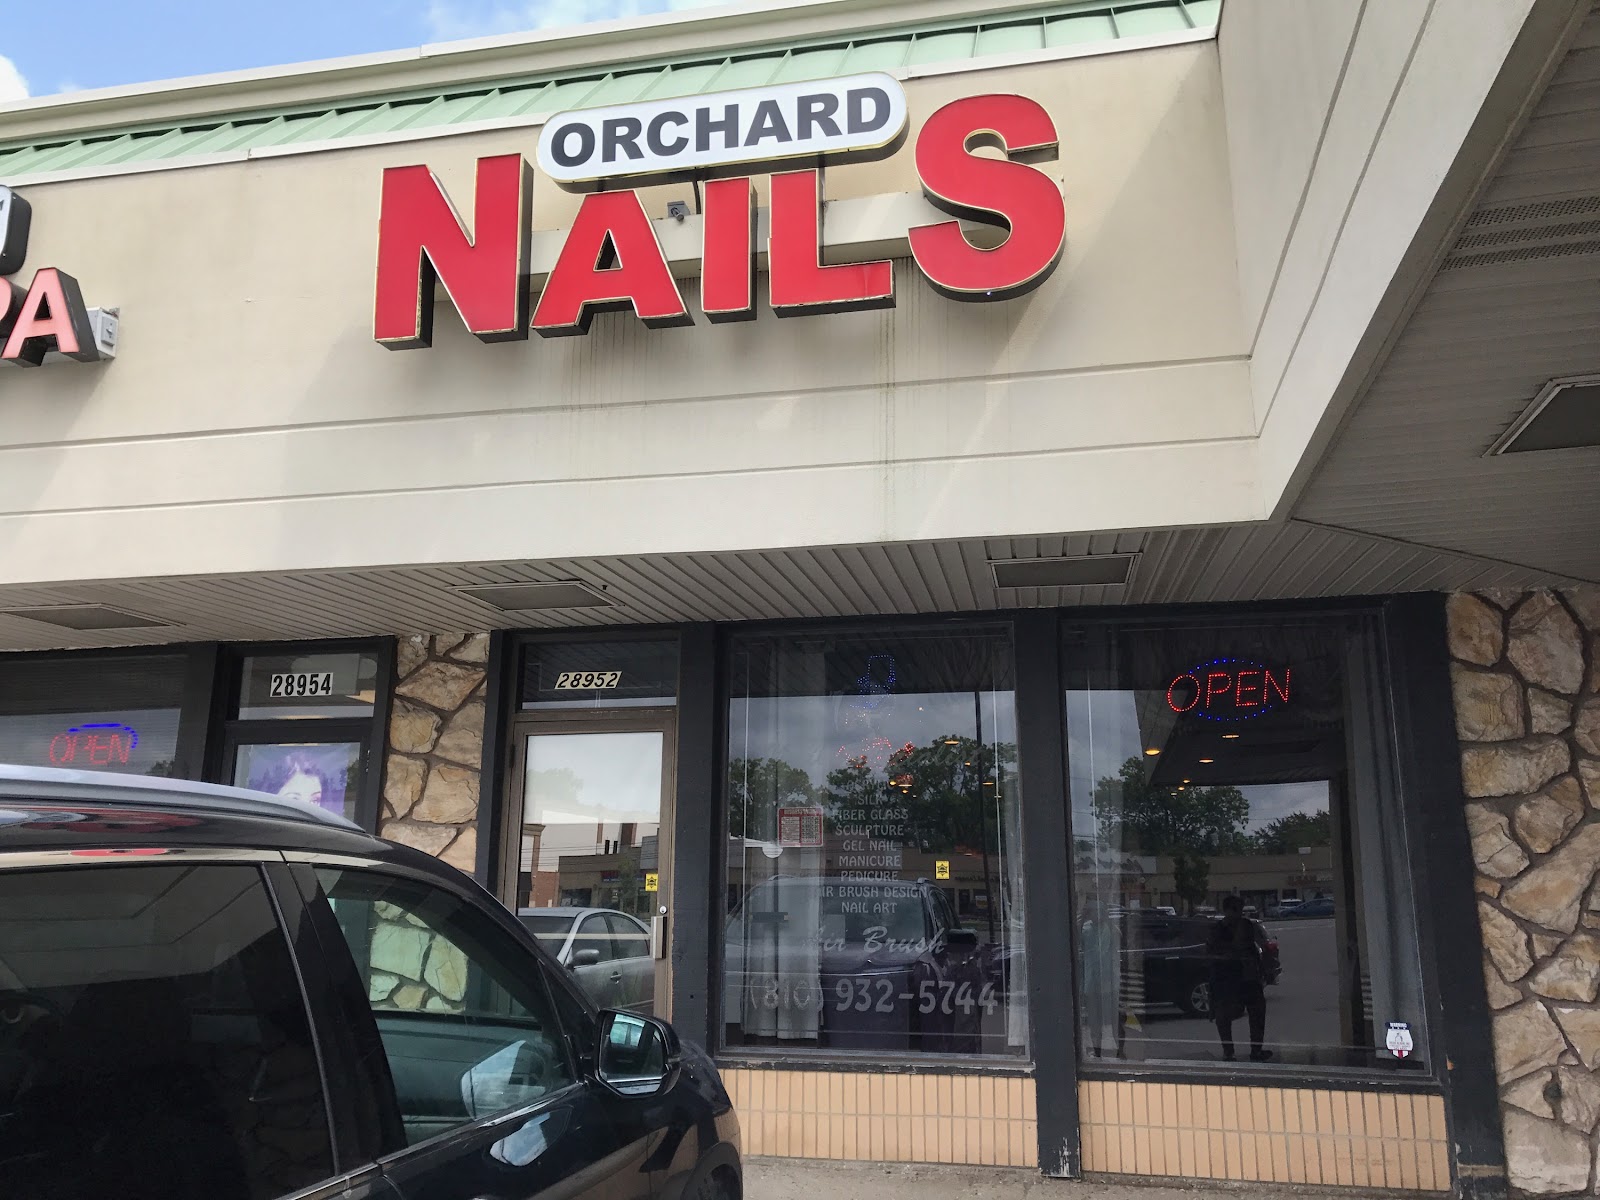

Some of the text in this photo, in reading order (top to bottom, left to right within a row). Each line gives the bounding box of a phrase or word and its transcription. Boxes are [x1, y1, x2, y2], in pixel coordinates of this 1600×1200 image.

[549, 86, 892, 168] ORCHARD
[373, 93, 1066, 344] NAILS
[271, 672, 332, 697] 28954
[556, 671, 621, 690] 28952
[1166, 668, 1291, 713] OPEN
[49, 733, 131, 766] OPEN
[857, 794, 884, 806] SILK
[870, 808, 909, 821] GLASS
[835, 824, 905, 836] SCULPTURE
[842, 839, 897, 852] GEL NAIL
[838, 855, 901, 867] MANICURE
[841, 870, 899, 882] PEDICURE
[839, 886, 879, 898] BRUSH
[884, 886, 928, 899] DESIGN
[841, 901, 898, 914] NAIL ART
[862, 925, 945, 954] Brush
[835, 978, 999, 1016] 932-5744
